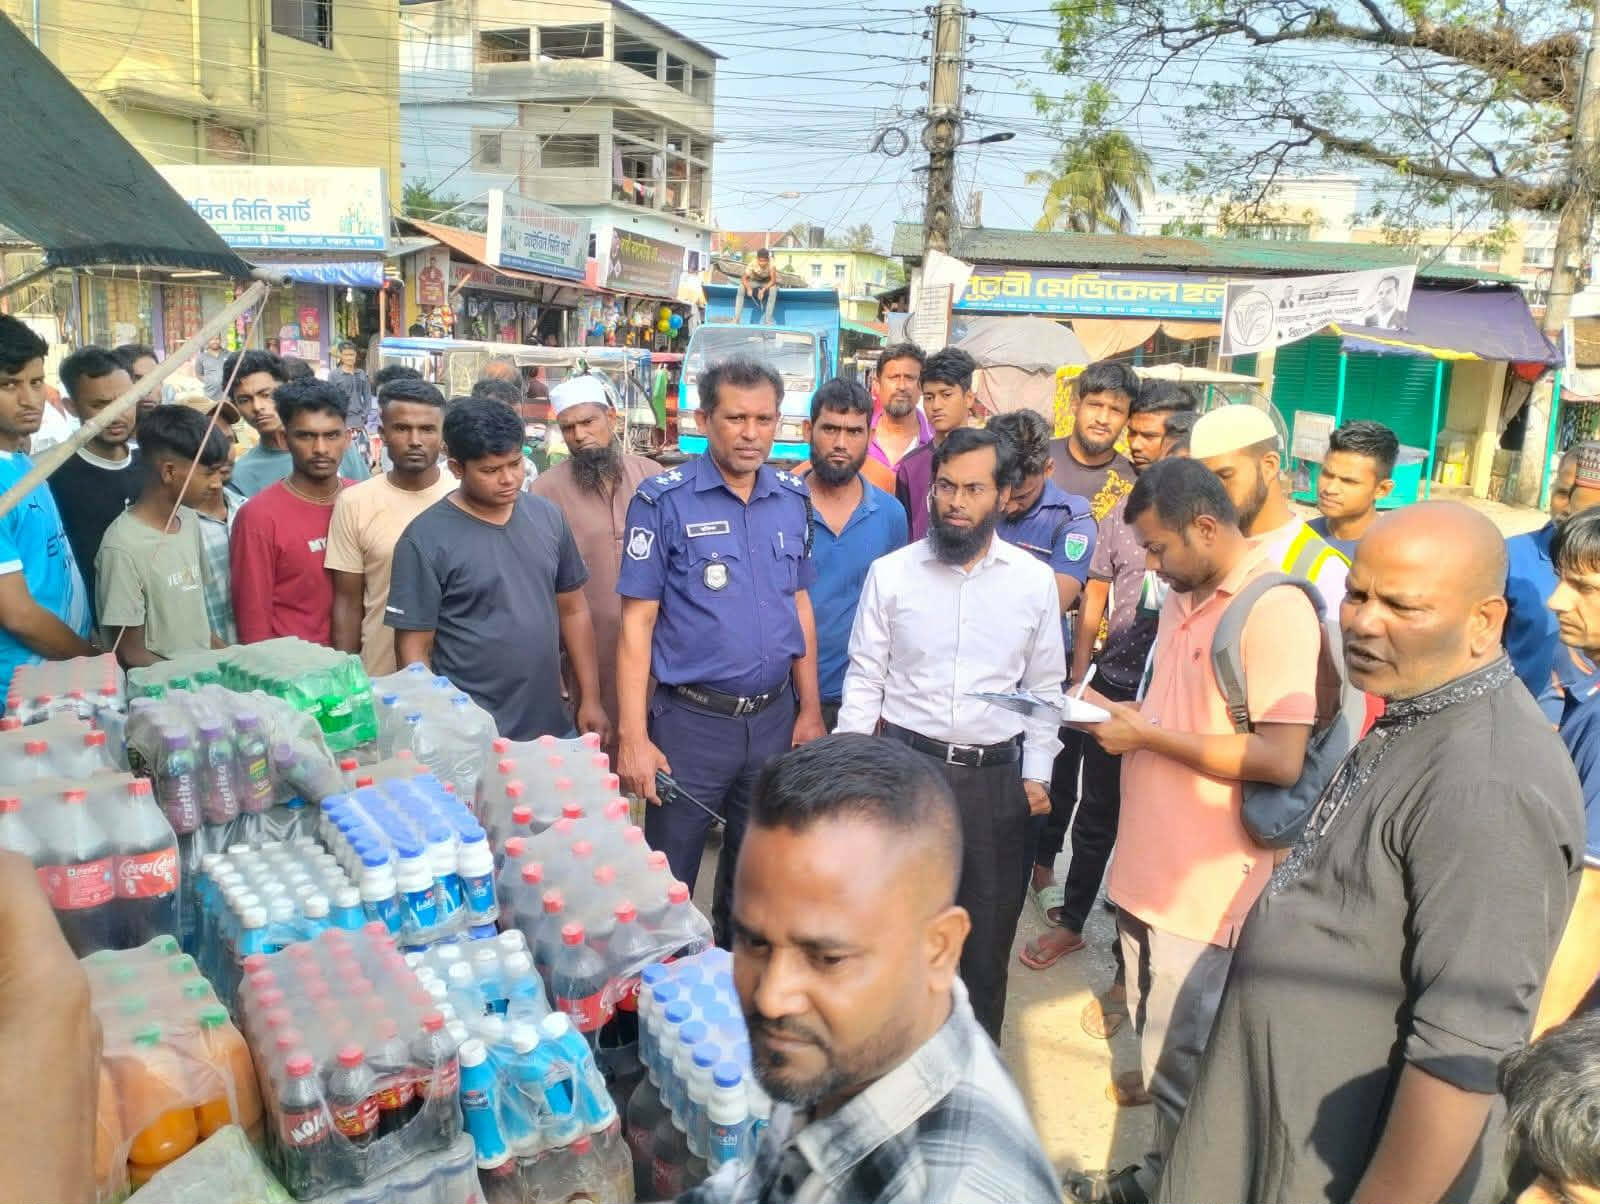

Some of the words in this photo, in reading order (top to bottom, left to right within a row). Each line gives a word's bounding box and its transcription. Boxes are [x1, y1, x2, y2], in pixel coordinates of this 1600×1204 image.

[232, 197, 272, 222] মিনি
[276, 199, 311, 224] মার্ট
[177, 775, 193, 827] Frutika
[215, 764, 234, 815] Frutika
